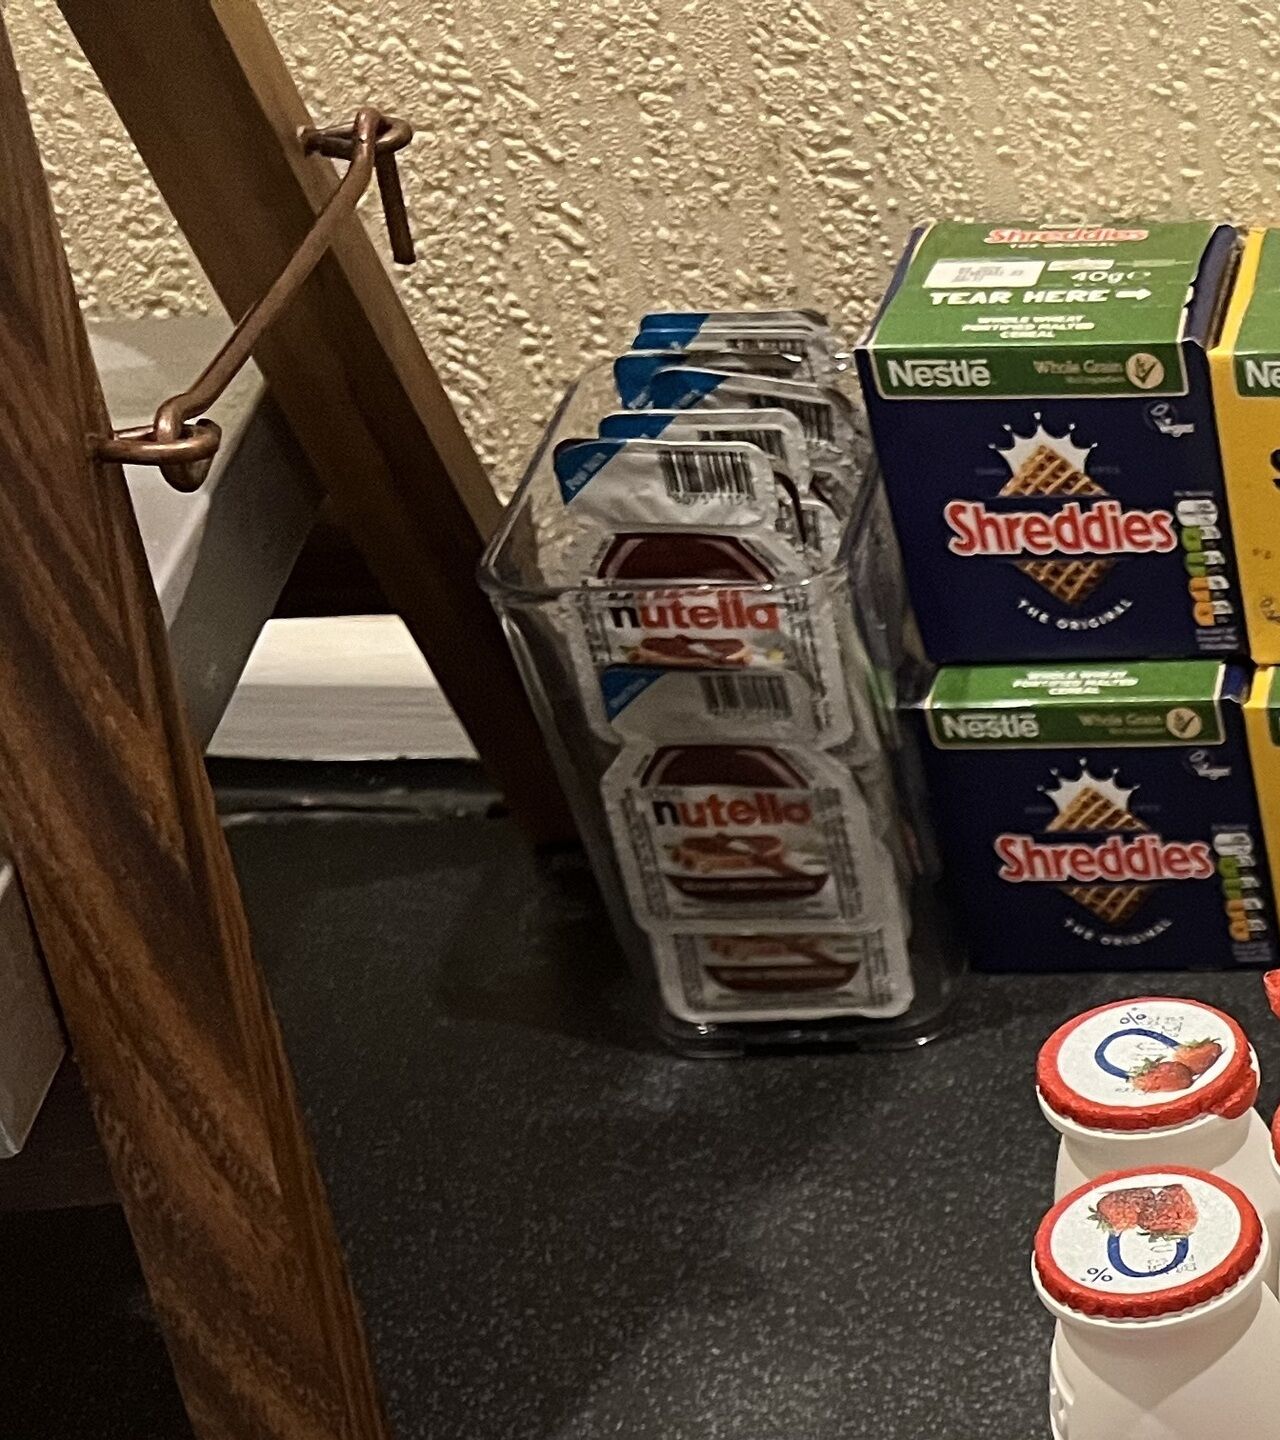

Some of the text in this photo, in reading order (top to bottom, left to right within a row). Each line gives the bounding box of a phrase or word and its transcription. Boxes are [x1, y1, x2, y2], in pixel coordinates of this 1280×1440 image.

[929, 289, 1110, 305] TEAR HERE
[945, 501, 1177, 554] Shreddies
[609, 595, 780, 630] nutella
[1017, 599, 1133, 631] THE ORIGINAL
[653, 793, 812, 827] nutella
[993, 833, 1215, 882] Shreddies
